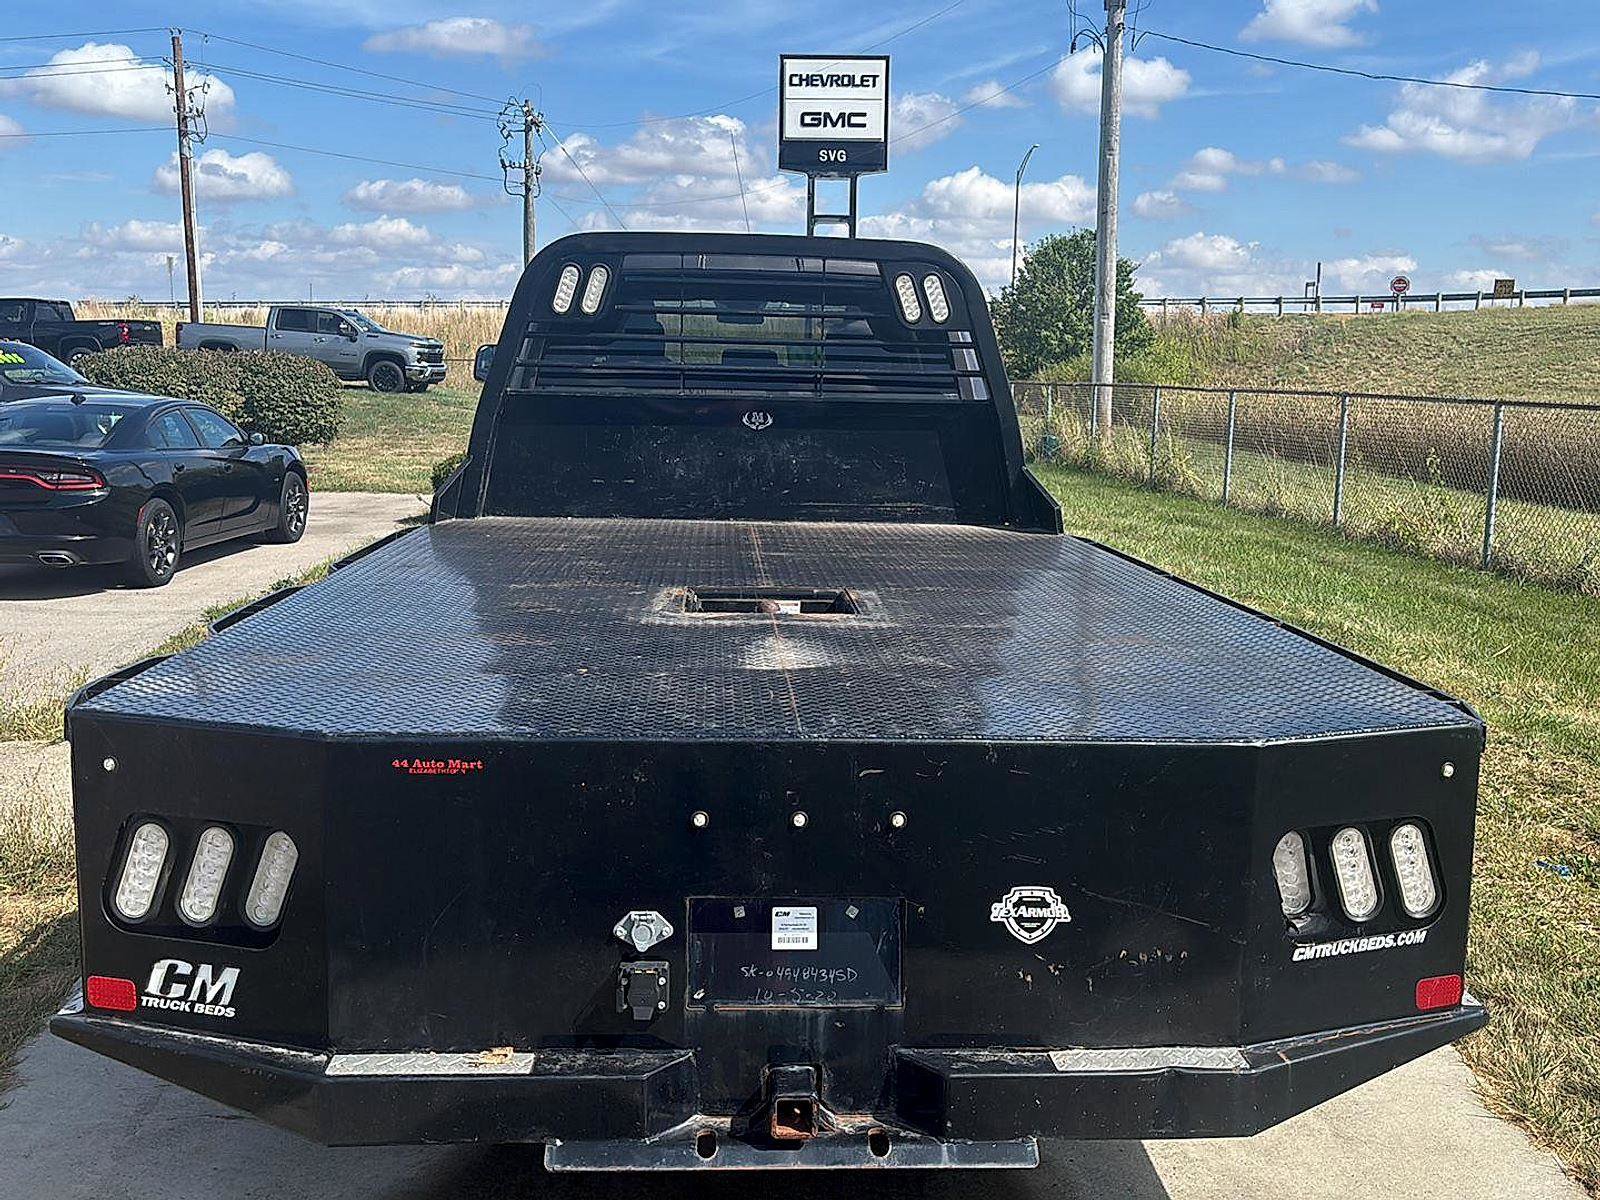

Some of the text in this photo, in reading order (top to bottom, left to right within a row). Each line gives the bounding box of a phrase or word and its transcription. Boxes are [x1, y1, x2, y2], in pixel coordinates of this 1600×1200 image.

[788, 73, 880, 88] CHEVROLET
[800, 111, 867, 128] GMC
[818, 149, 847, 162] SVG
[391, 758, 484, 769] 44 Auto Mart
[1292, 930, 1428, 961] CMTRUCKBEDS.COM
[144, 958, 241, 1006] CM
[140, 995, 236, 1018] TRUCK BEDS
